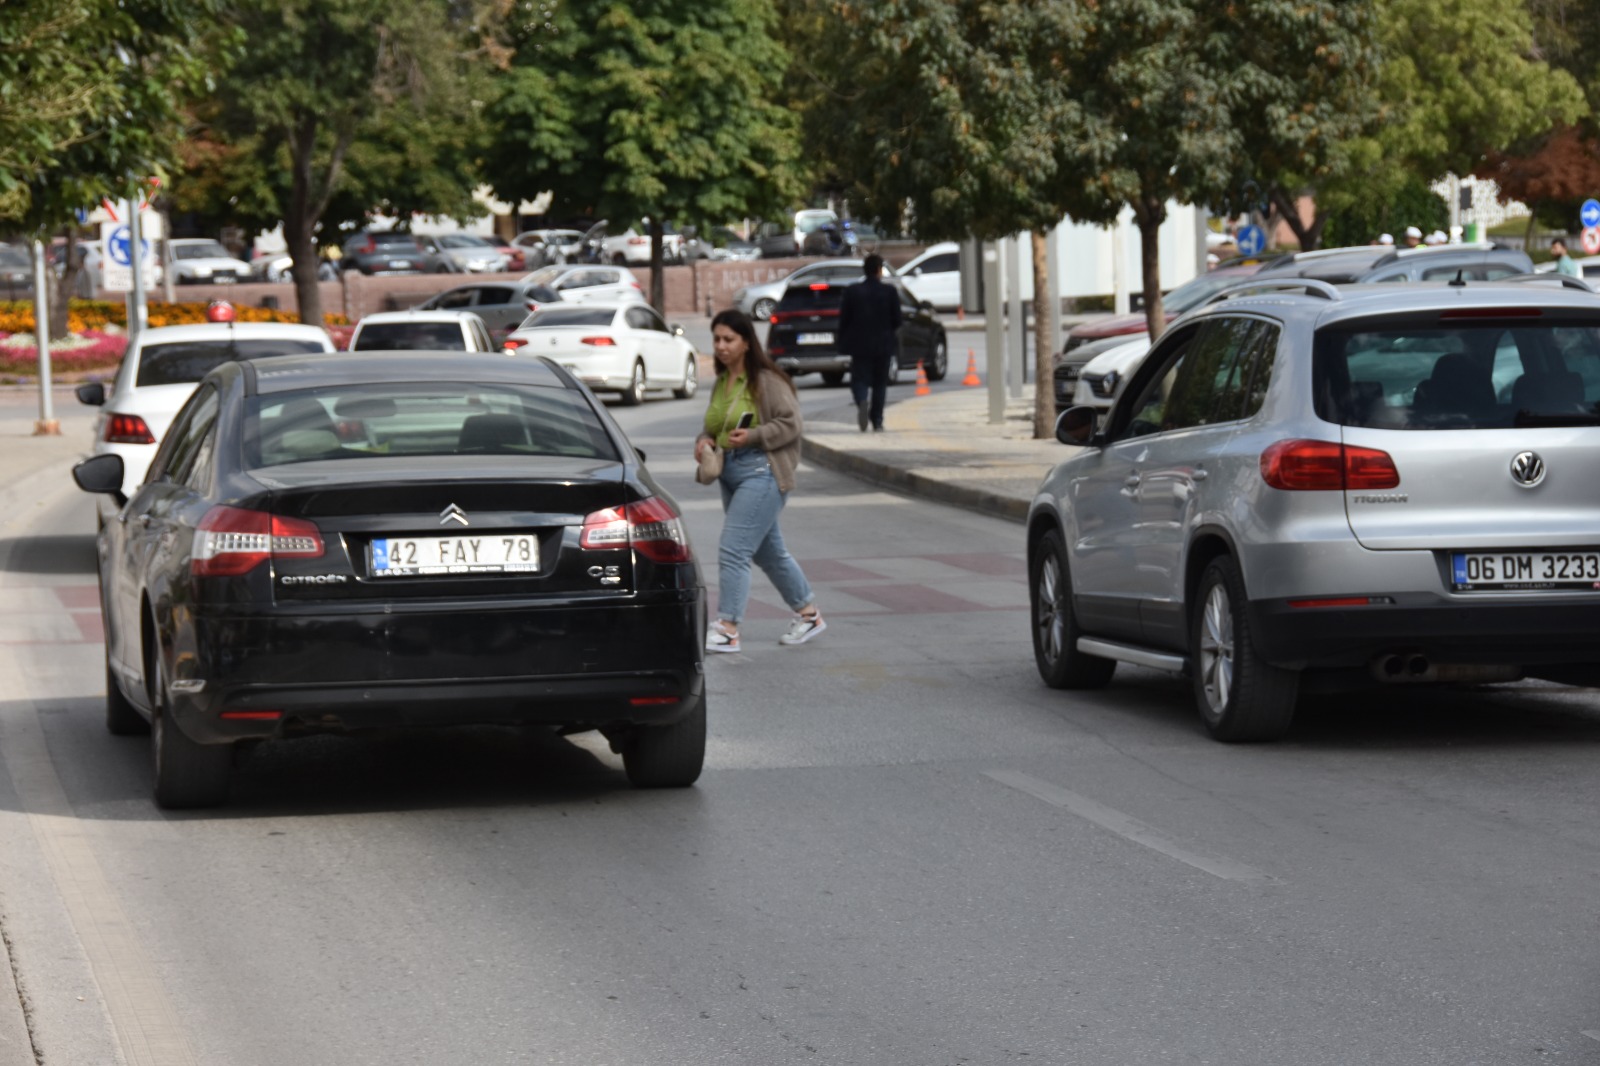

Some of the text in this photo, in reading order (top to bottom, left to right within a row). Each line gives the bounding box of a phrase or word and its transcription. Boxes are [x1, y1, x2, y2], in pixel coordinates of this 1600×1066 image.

[1352, 494, 1408, 504] TIGUAN
[389, 538, 531, 564] 42 FAY 78
[587, 565, 619, 577] C5
[1467, 555, 1599, 580] 06 DM 3233
